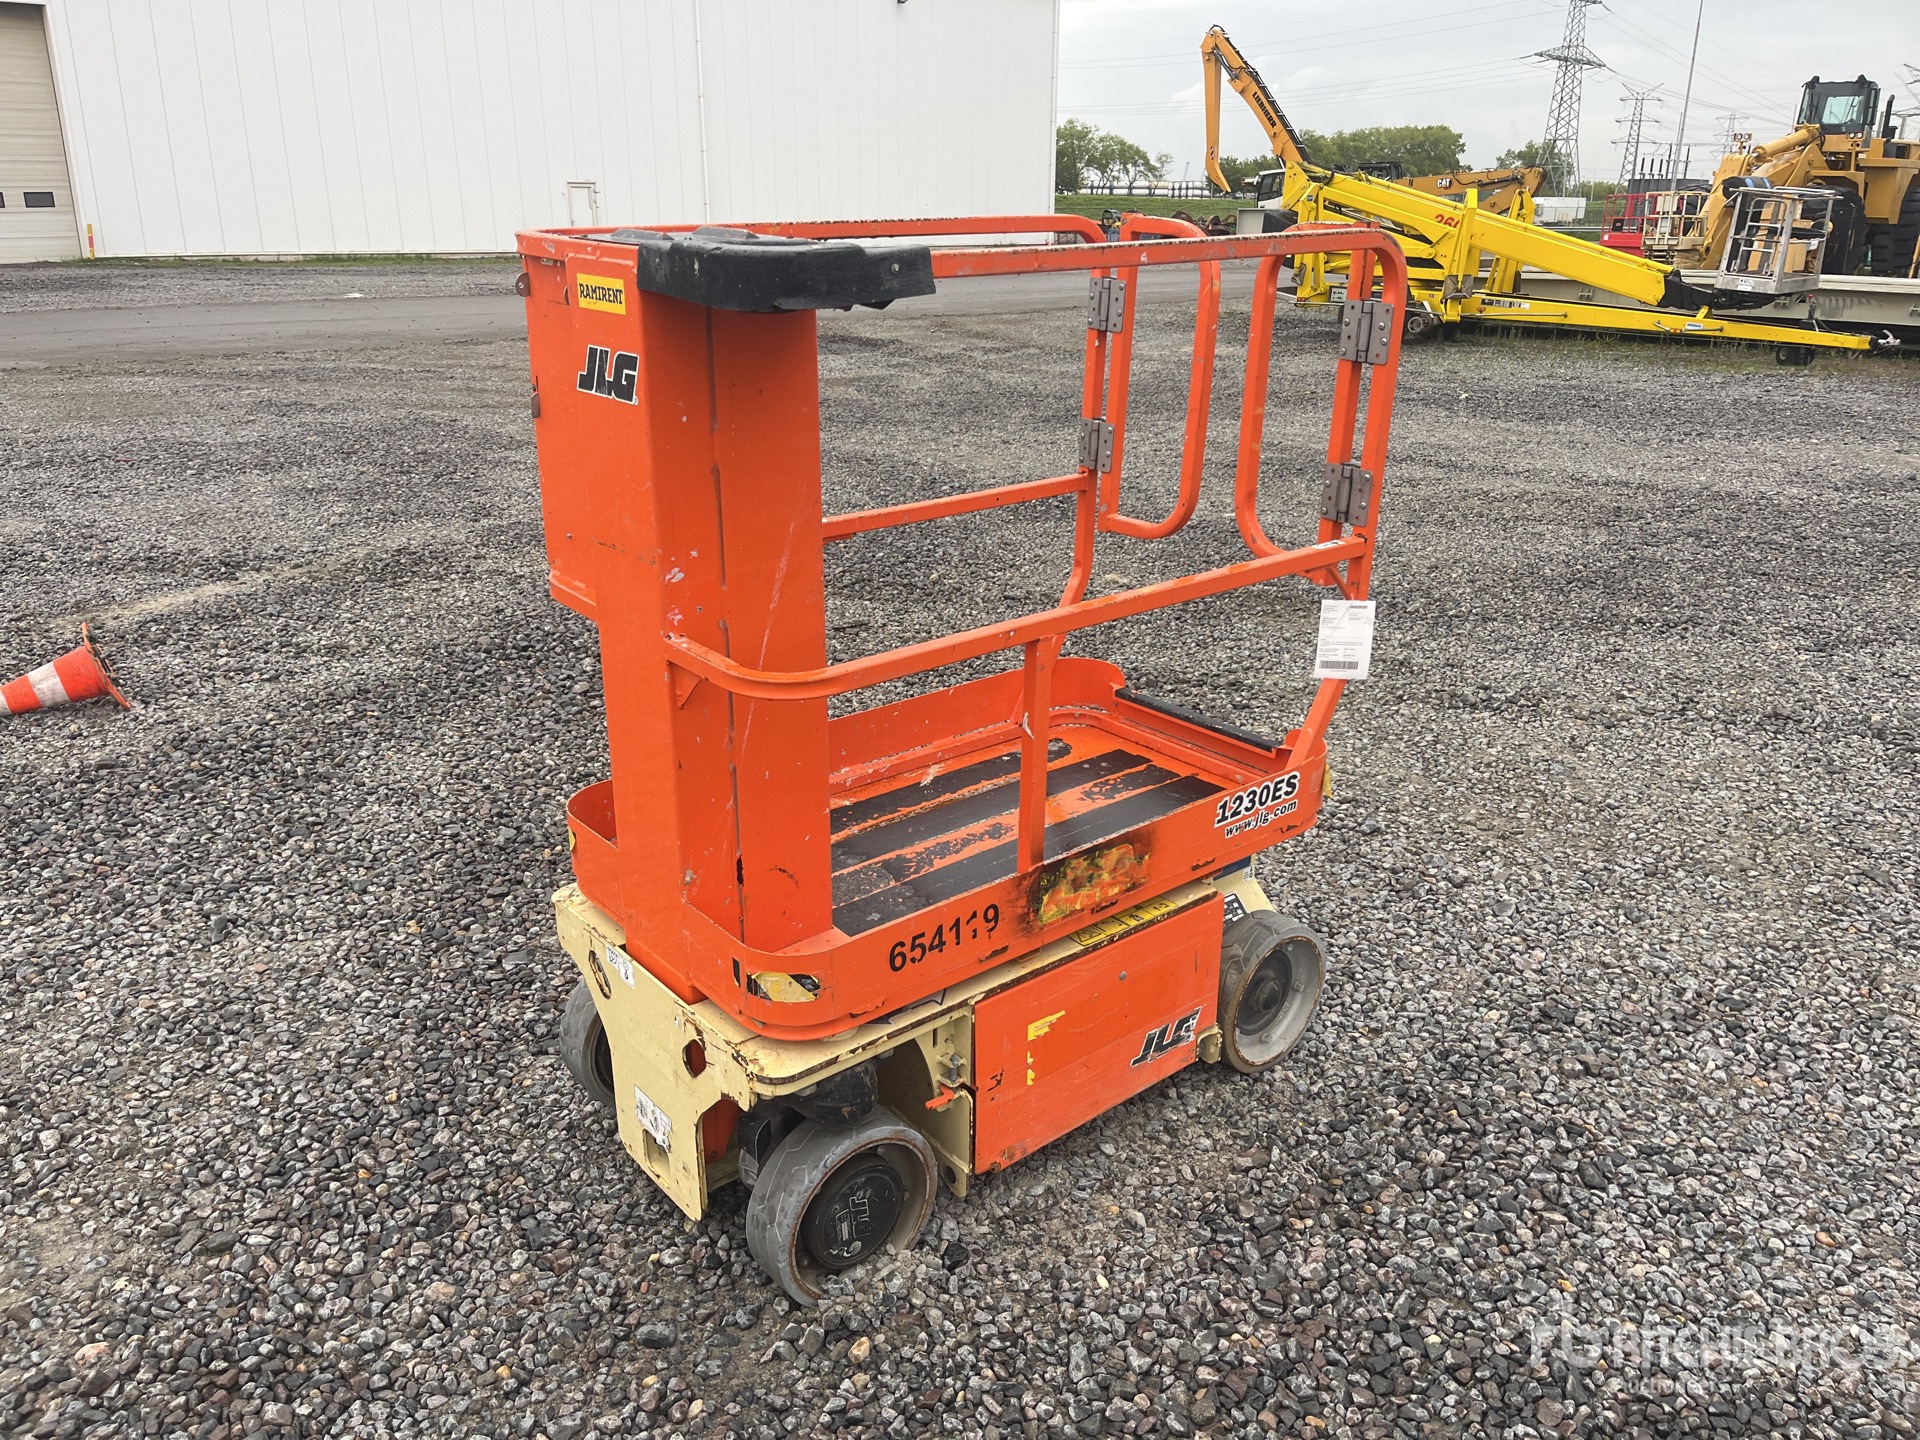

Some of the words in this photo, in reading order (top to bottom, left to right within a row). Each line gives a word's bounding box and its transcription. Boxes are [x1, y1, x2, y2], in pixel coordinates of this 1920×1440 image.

[1437, 178, 1451, 188] CAT
[578, 283, 623, 305] RAMIRENT
[577, 344, 639, 404] JLG
[1215, 772, 1300, 827] 1230ES
[1225, 800, 1298, 838] www.jlg.com
